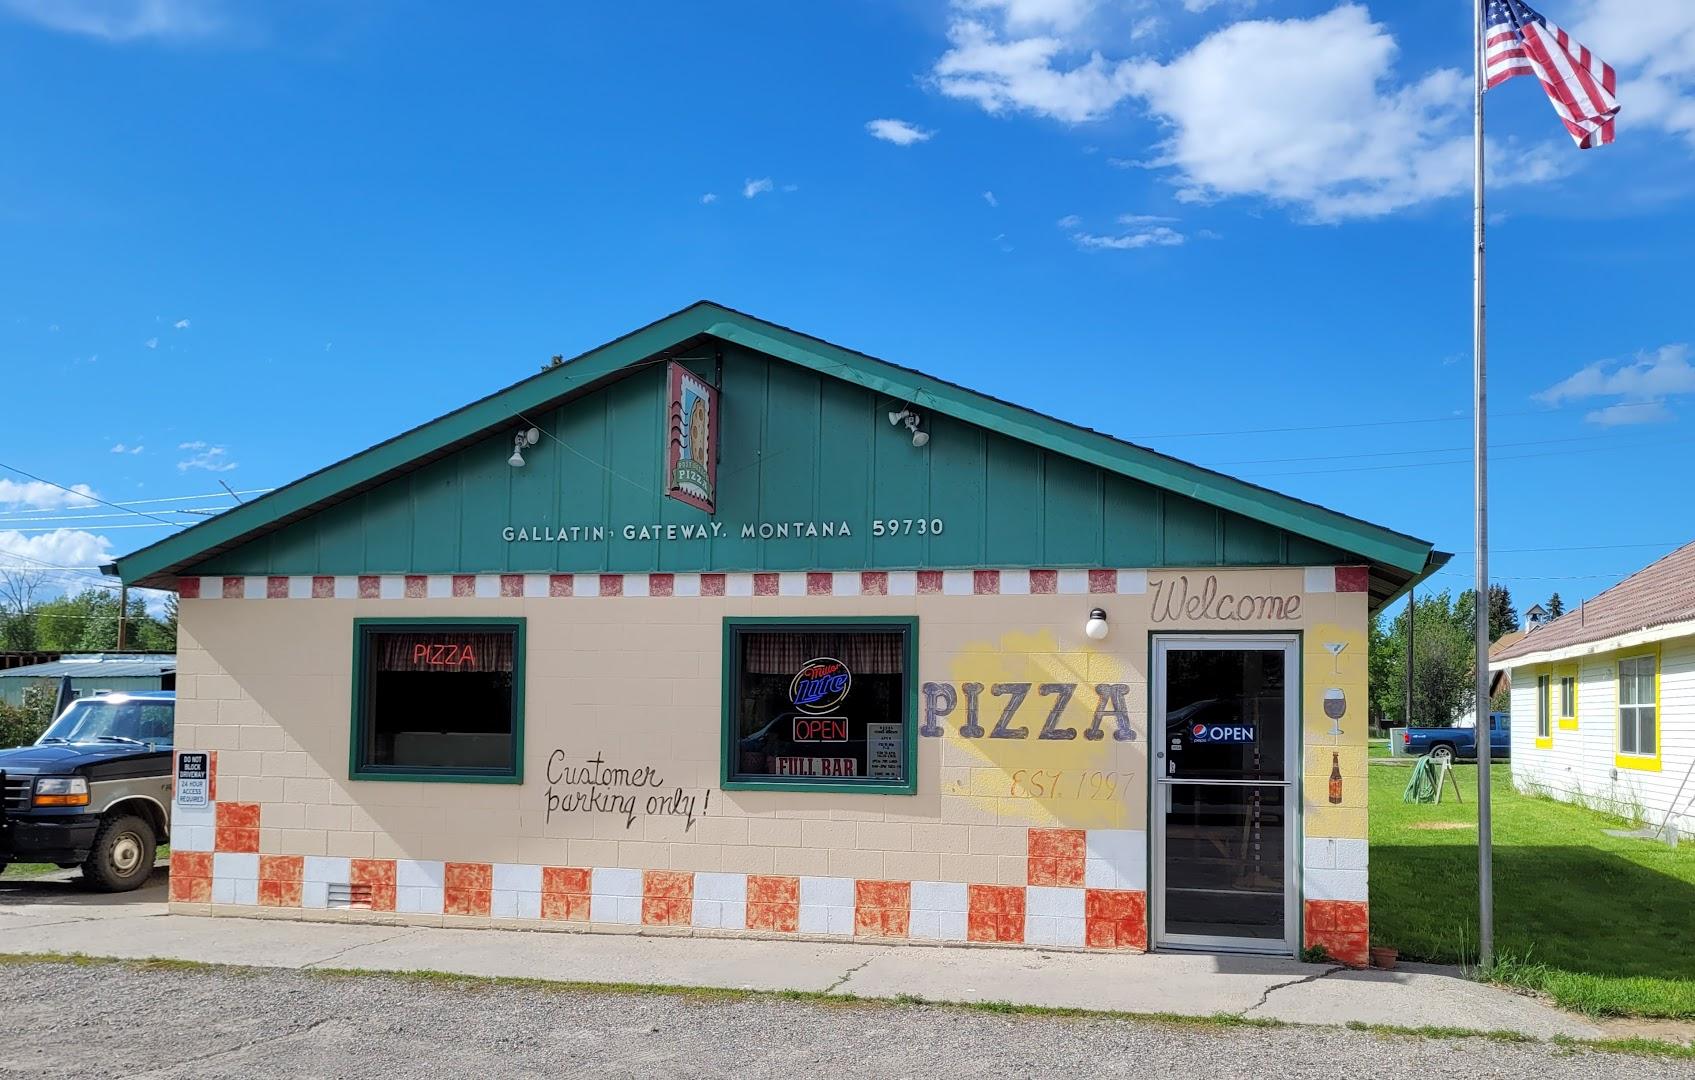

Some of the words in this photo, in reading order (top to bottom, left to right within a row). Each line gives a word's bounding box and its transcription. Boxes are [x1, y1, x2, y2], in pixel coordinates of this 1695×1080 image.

[678, 469, 709, 491] PIZZA
[741, 521, 852, 538] MONTANA
[873, 518, 944, 536] 59730
[1149, 575, 1302, 623] Welcome
[413, 643, 476, 666] PIZZA
[804, 664, 842, 680] Miller
[793, 673, 848, 705] Lite
[920, 681, 1138, 742] PIZZA
[796, 720, 846, 740] OPEN
[1210, 727, 1254, 741] OPEN
[546, 749, 664, 788] Customer
[779, 758, 817, 776] FULL
[821, 758, 854, 777] BAR
[1076, 771, 1135, 800] 1997
[544, 786, 637, 830] parking
